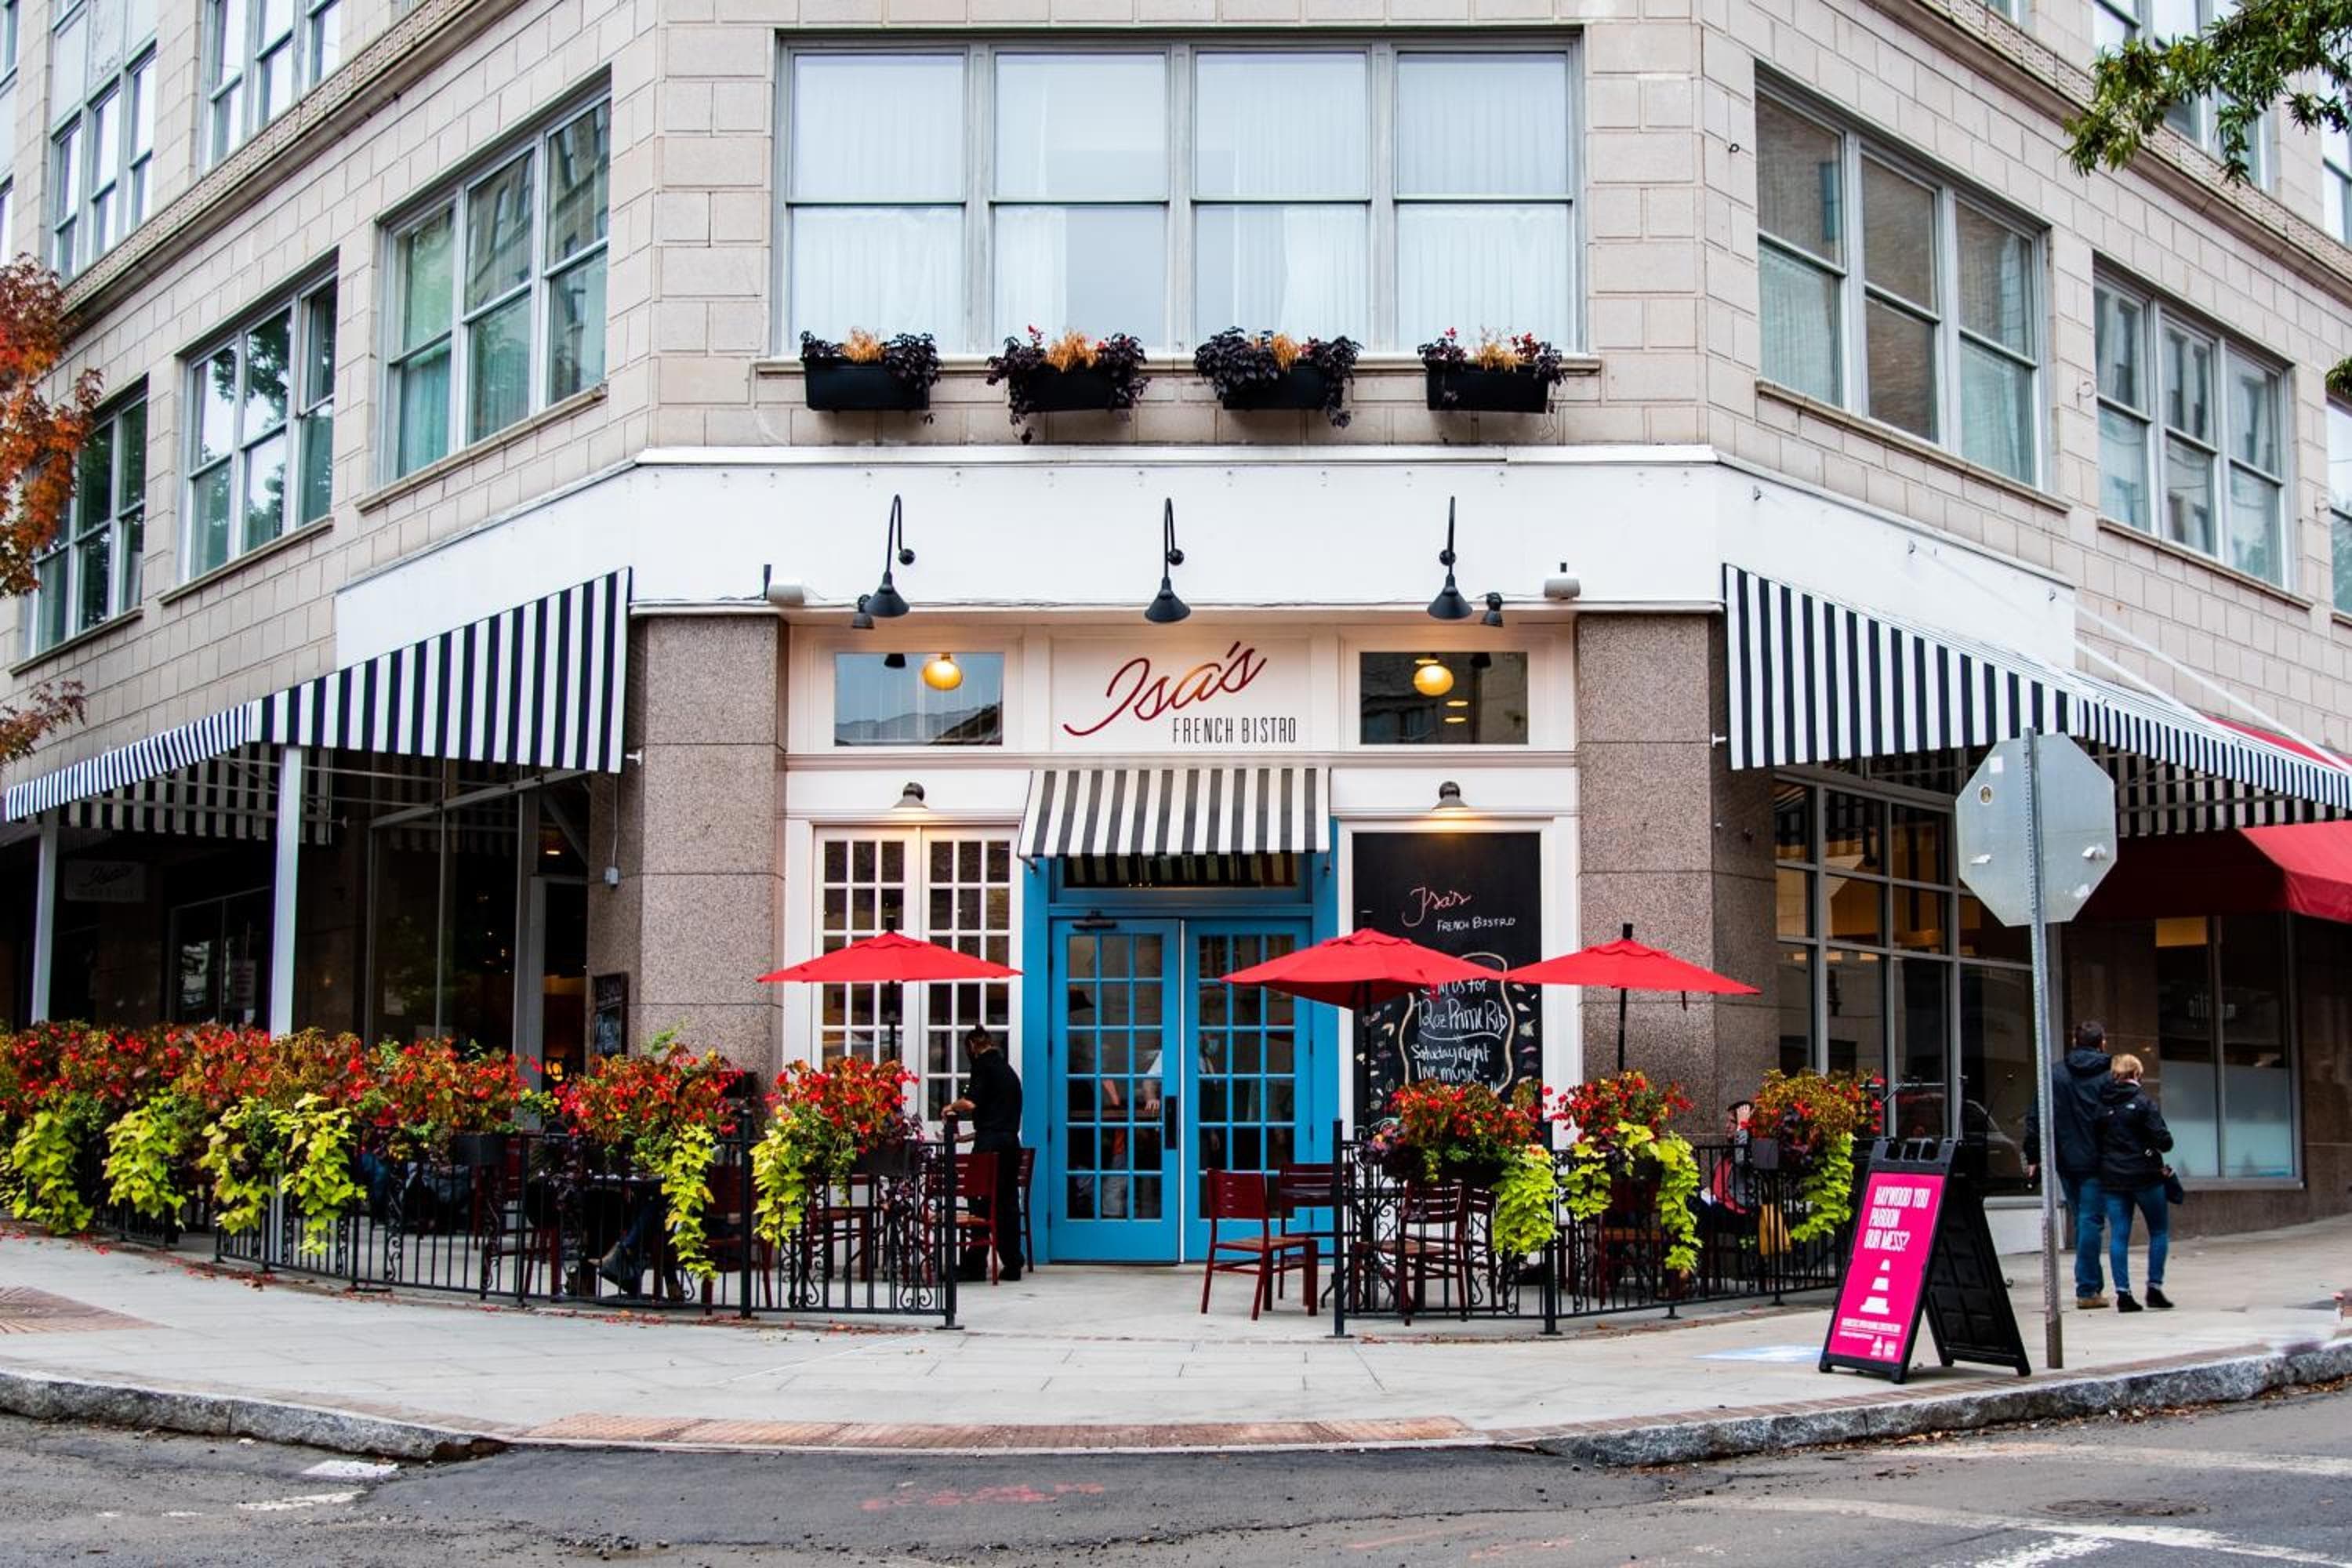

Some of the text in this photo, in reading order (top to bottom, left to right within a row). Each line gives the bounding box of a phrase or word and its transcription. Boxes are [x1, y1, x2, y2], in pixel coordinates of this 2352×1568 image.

[1062, 641, 1268, 736] Isa's
[1173, 717, 1297, 744] FRENCH BISTRO
[1401, 886, 1472, 927] Isa's
[1484, 999, 1508, 1035] Rib
[1880, 1229, 1911, 1252] MESS?
